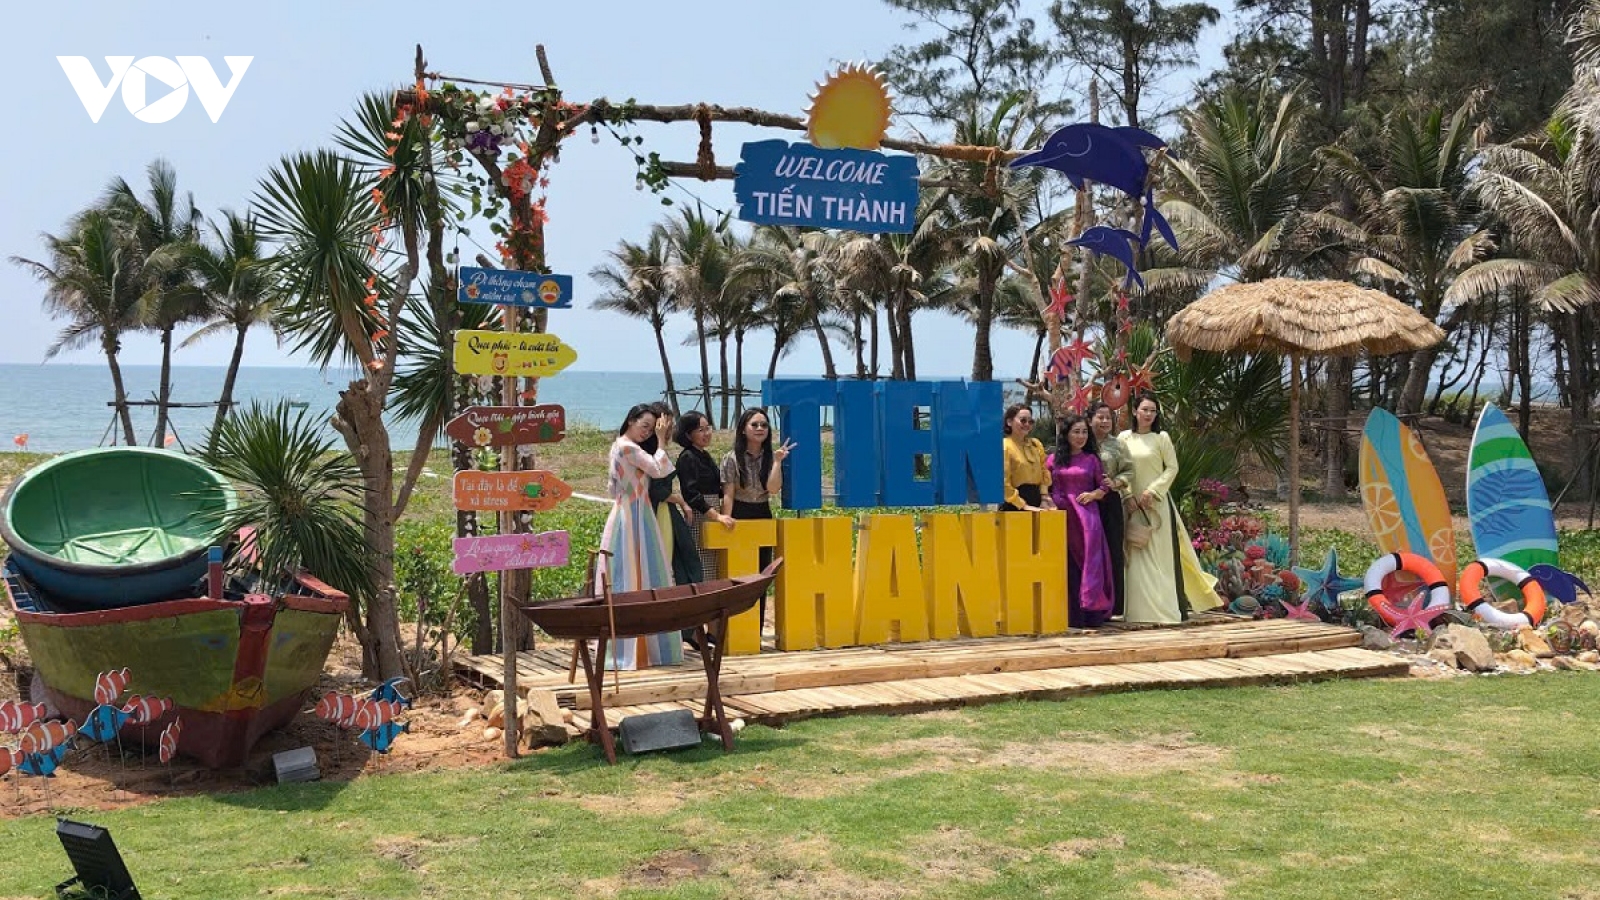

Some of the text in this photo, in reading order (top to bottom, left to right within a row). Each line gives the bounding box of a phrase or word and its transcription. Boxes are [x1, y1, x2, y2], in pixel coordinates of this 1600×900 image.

[775, 154, 889, 184] WELCOME
[752, 184, 906, 224] TIẾN THÀNH
[761, 379, 1003, 509] TIEN
[496, 478, 505, 491] là
[704, 510, 1068, 656] THANH
